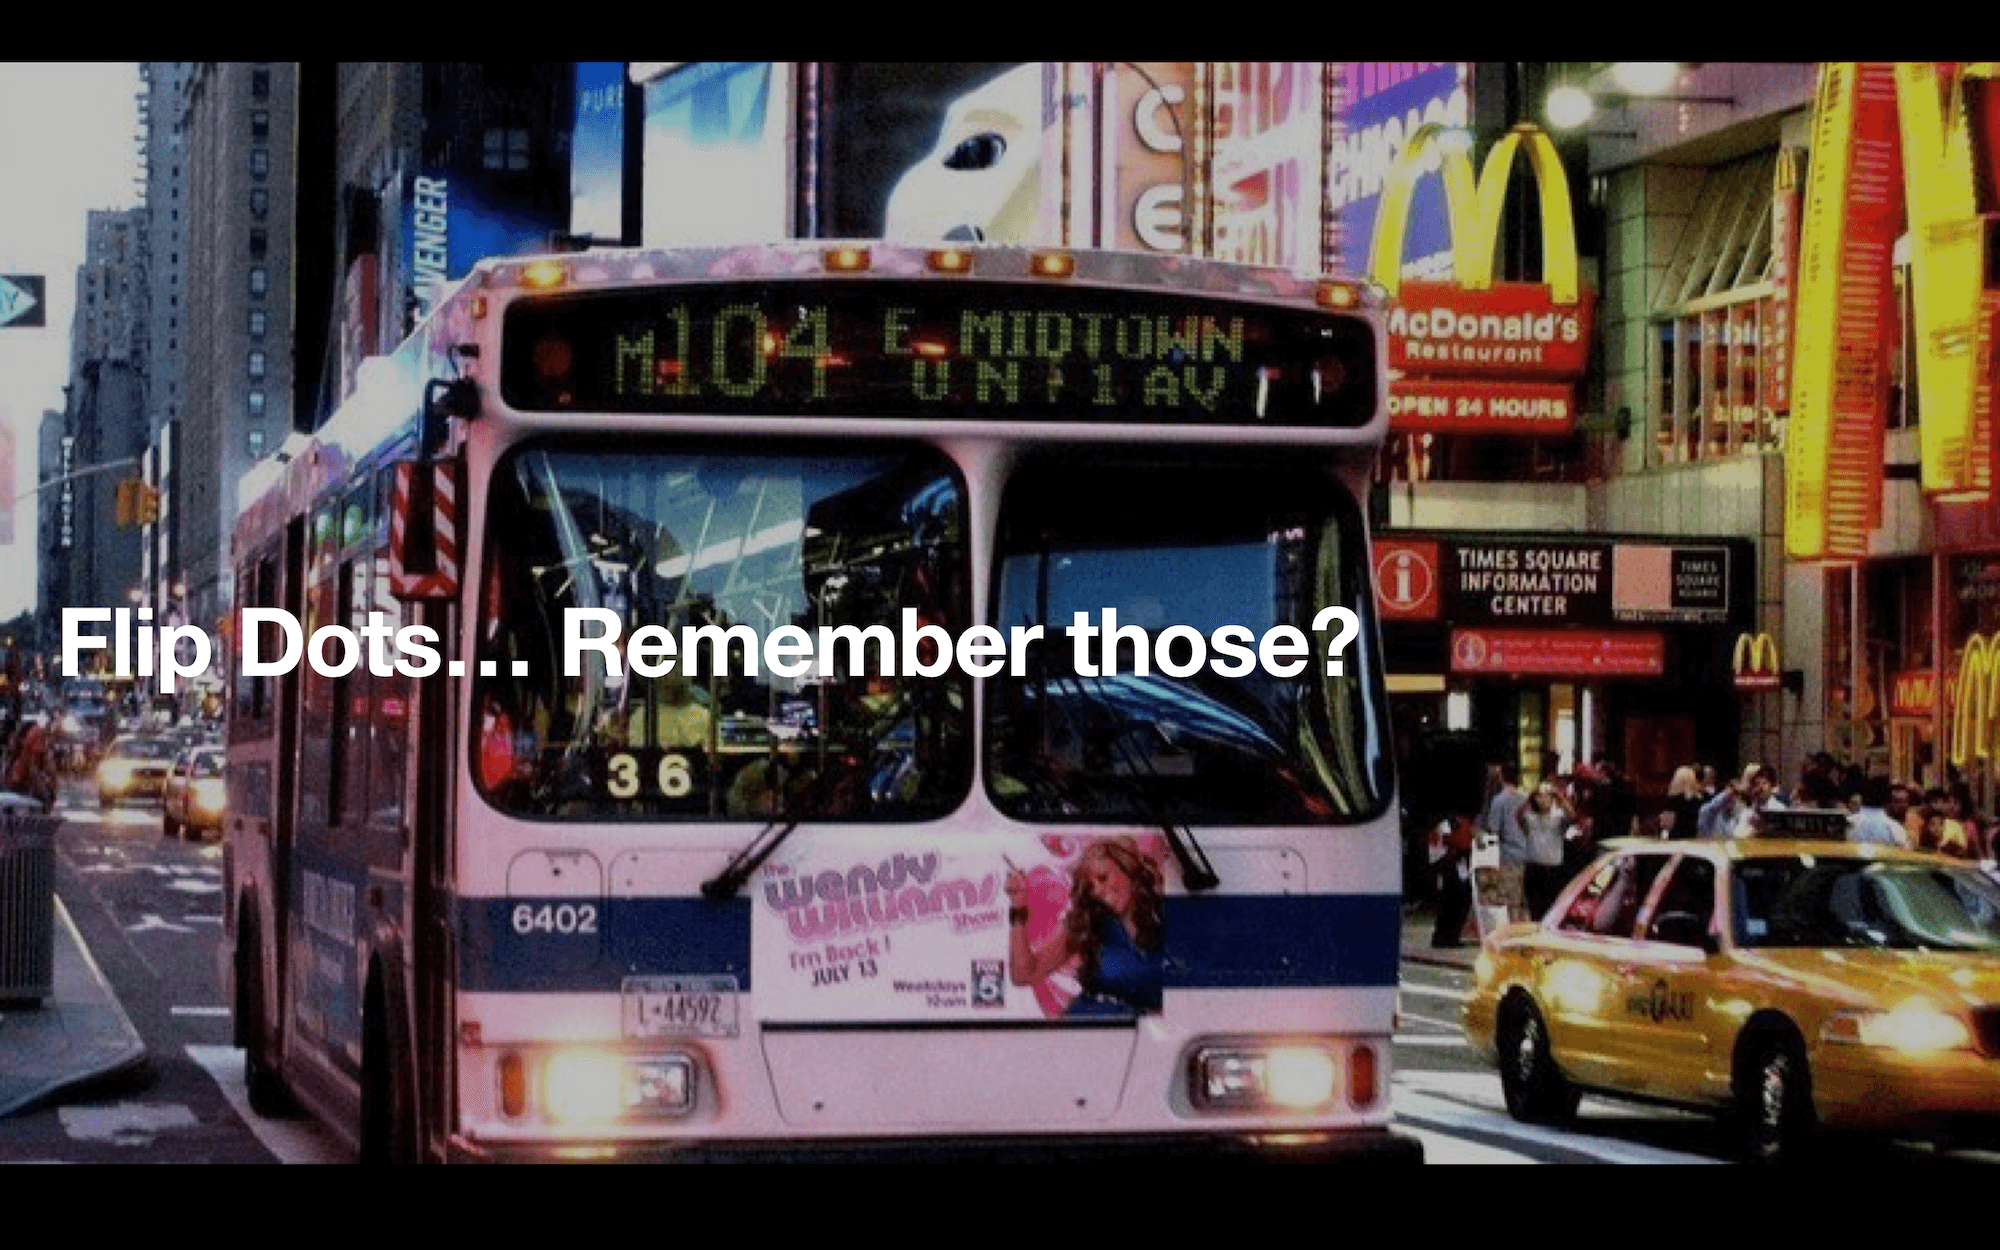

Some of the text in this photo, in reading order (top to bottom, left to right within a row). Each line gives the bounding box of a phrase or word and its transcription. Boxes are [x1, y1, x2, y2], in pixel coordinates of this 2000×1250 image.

[959, 310, 1244, 363] MIDTOWN
[1387, 307, 1578, 343] McDonald's
[616, 302, 832, 398] M104
[1404, 342, 1544, 364] Restaurant
[1142, 366, 1226, 412] AV
[1385, 396, 1568, 420] OPEN 24 HOURS
[1458, 549, 1602, 572] TIMES SQUARE
[1460, 572, 1598, 594] INFORMATION
[1491, 595, 1568, 616] CENTER
[511, 903, 598, 935] 6402
[812, 958, 880, 988] JULY 13
